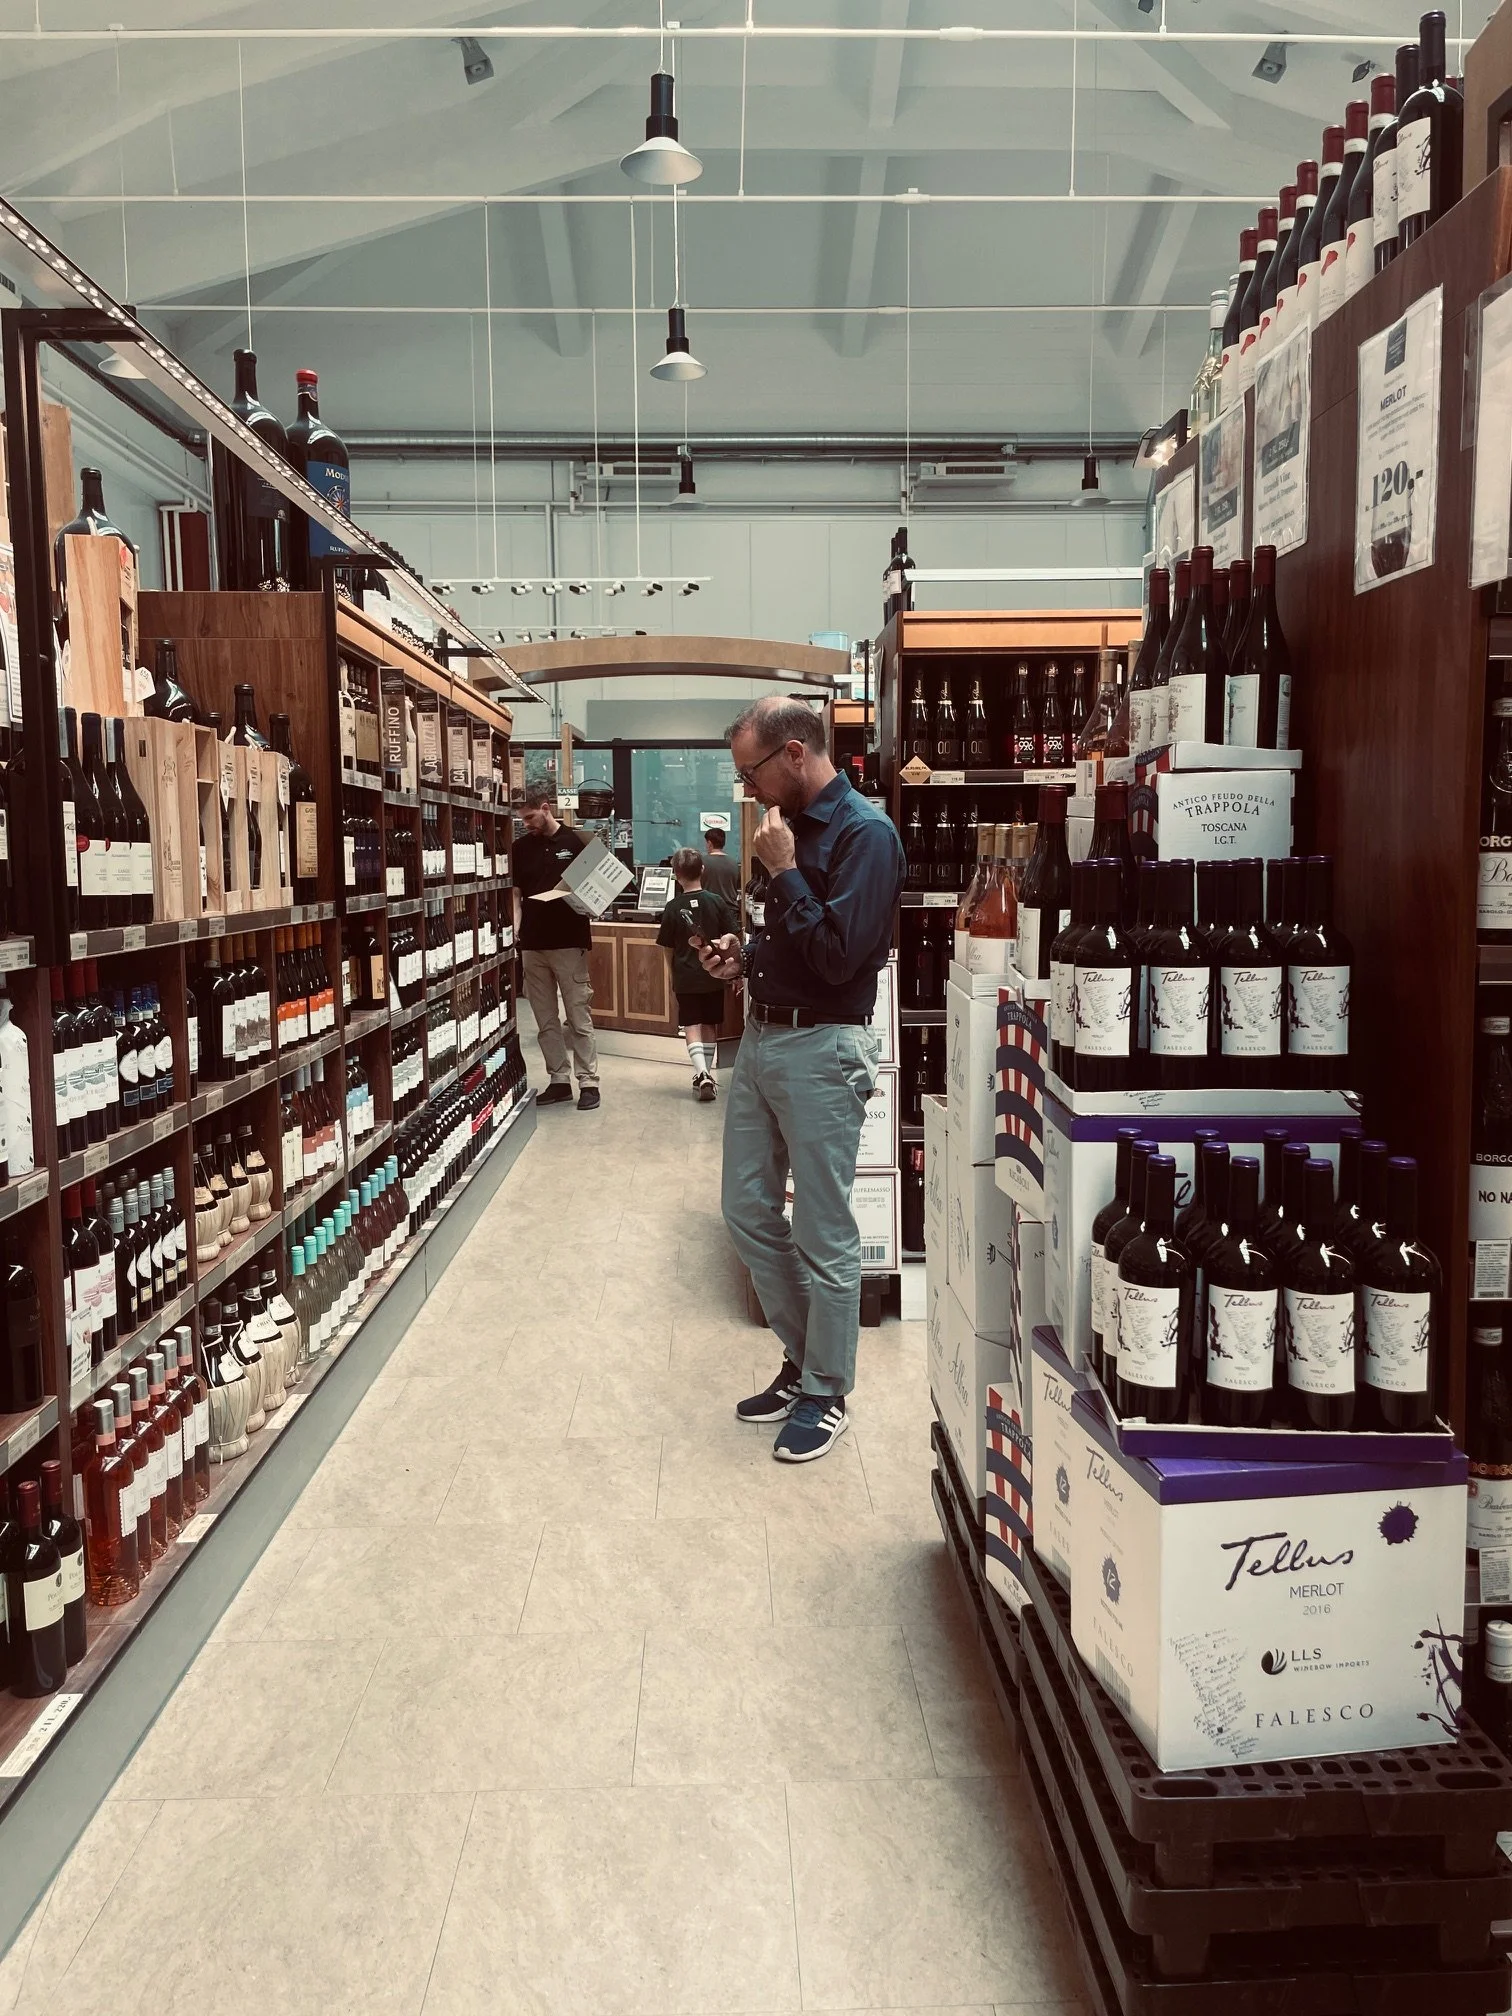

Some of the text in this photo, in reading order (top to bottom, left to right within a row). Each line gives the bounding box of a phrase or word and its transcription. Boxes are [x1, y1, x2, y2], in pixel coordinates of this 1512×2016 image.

[1380, 385, 1407, 411] MERLOT
[421, 714, 435, 722] VINE
[387, 707, 403, 764] RUFFINO
[564, 797, 571, 806] 2
[1172, 793, 1276, 811] ANTICO FEUDO DELLA
[1184, 801, 1261, 819] TRAPPOLA
[1200, 822, 1247, 832] TOSCANA
[1213, 835, 1237, 845] I.G.T.
[1083, 971, 1115, 984] Tellus
[1161, 971, 1196, 984] Tellus
[1233, 971, 1269, 984] Tellus
[1300, 970, 1337, 984] Tellus
[1478, 1190, 1496, 1203] NO
[1123, 1287, 1159, 1303] Tellus
[1224, 1294, 1263, 1308] Tellus
[1370, 1293, 1410, 1309] Tellus
[1296, 1297, 1335, 1312] Tellus
[1086, 1445, 1124, 1503] Tellus
[1220, 1531, 1354, 1591] Tellus
[1106, 1568, 1116, 1591] 12
[1289, 1582, 1344, 1599] MERLOT
[1302, 1603, 1332, 1616] 2016
[1093, 1616, 1134, 1678] FALESCO
[1291, 1647, 1322, 1661] LLS
[1294, 1659, 1370, 1673] WINEBOW IMPORTS
[1255, 1702, 1375, 1728] FALESCO
